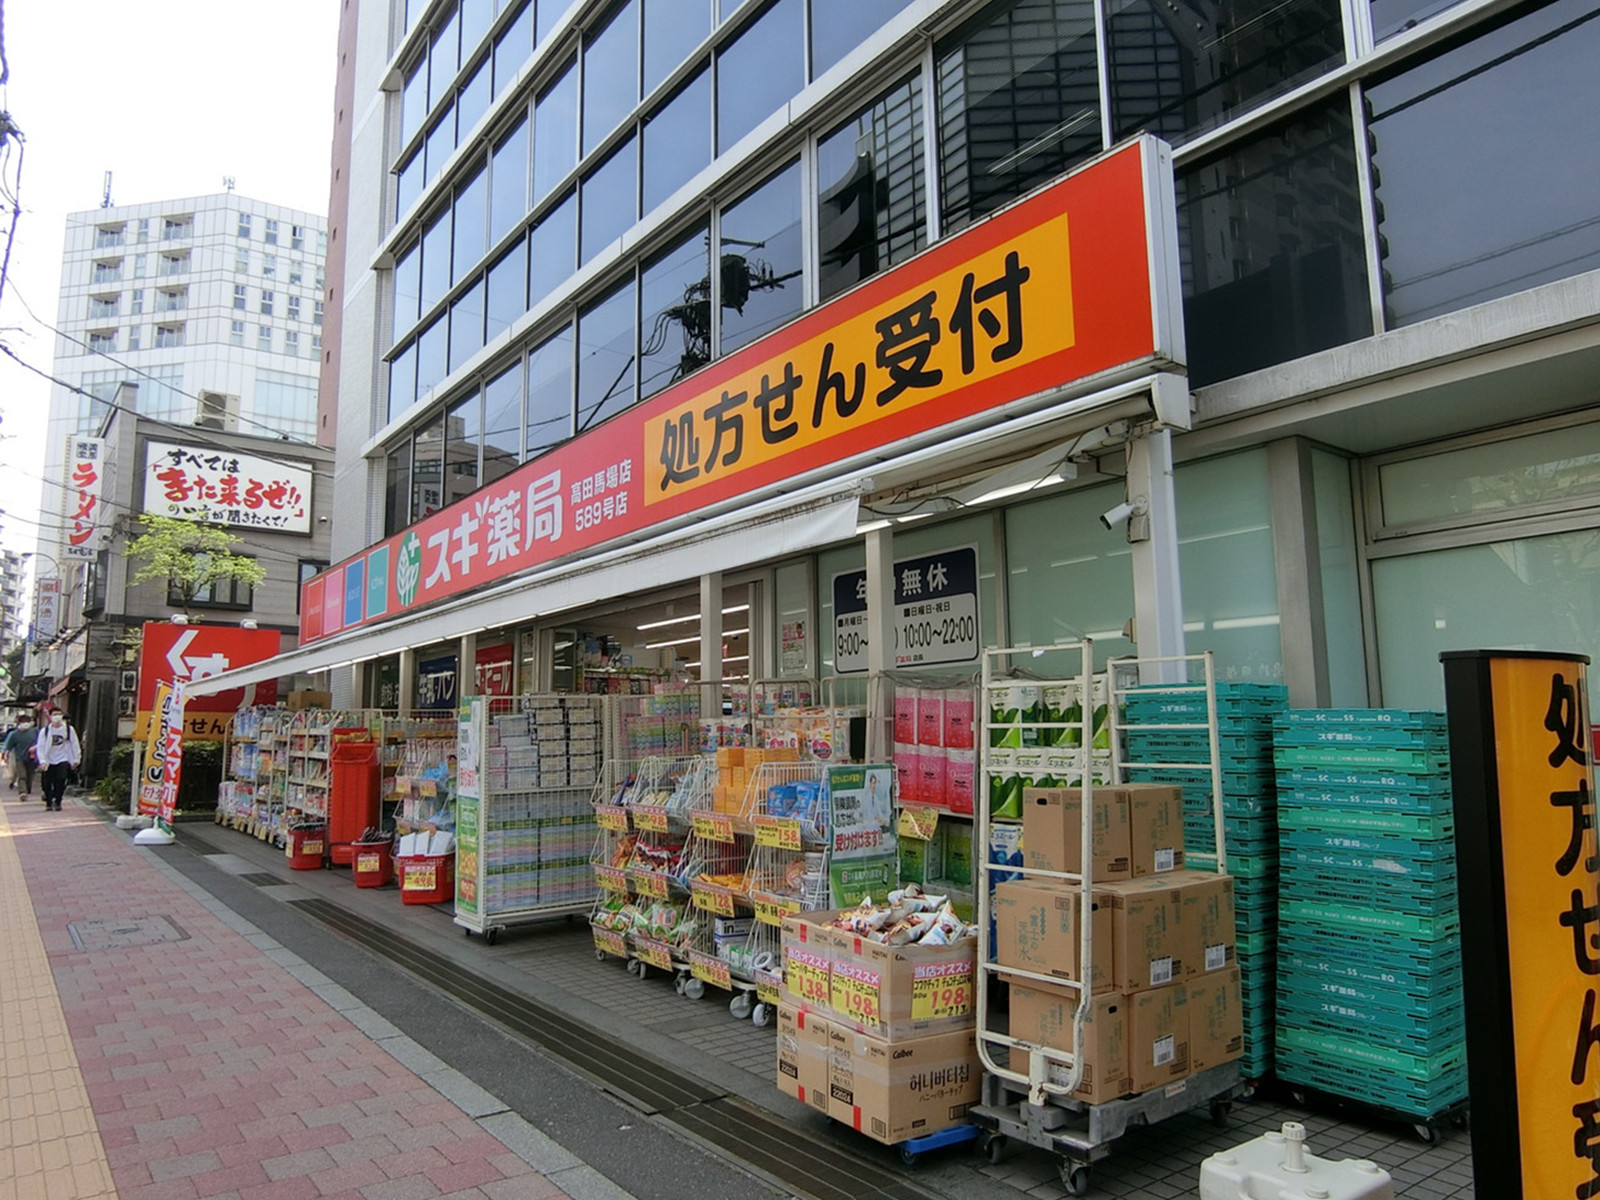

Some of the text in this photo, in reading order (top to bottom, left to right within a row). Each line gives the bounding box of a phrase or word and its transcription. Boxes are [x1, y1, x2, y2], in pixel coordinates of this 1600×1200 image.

[660, 250, 1031, 490] 処方せん受付
[168, 448, 241, 473] すべては
[571, 459, 632, 506] 高田馬場店
[68, 462, 98, 546] ラーメン
[575, 491, 628, 532] 589号店
[425, 469, 562, 590] スギ薬局
[1318, 774, 1329, 782] SC
[1347, 775, 1357, 783] SS
[1321, 793, 1332, 801] SC
[1350, 795, 1360, 803] SS
[1323, 856, 1362, 867] SC SS
[723, 922, 735, 934] in
[1319, 963, 1329, 971] SC
[1346, 967, 1357, 976] SS
[892, 1049, 913, 1059] Calbee
[909, 1063, 970, 1092] 허니버터칩
